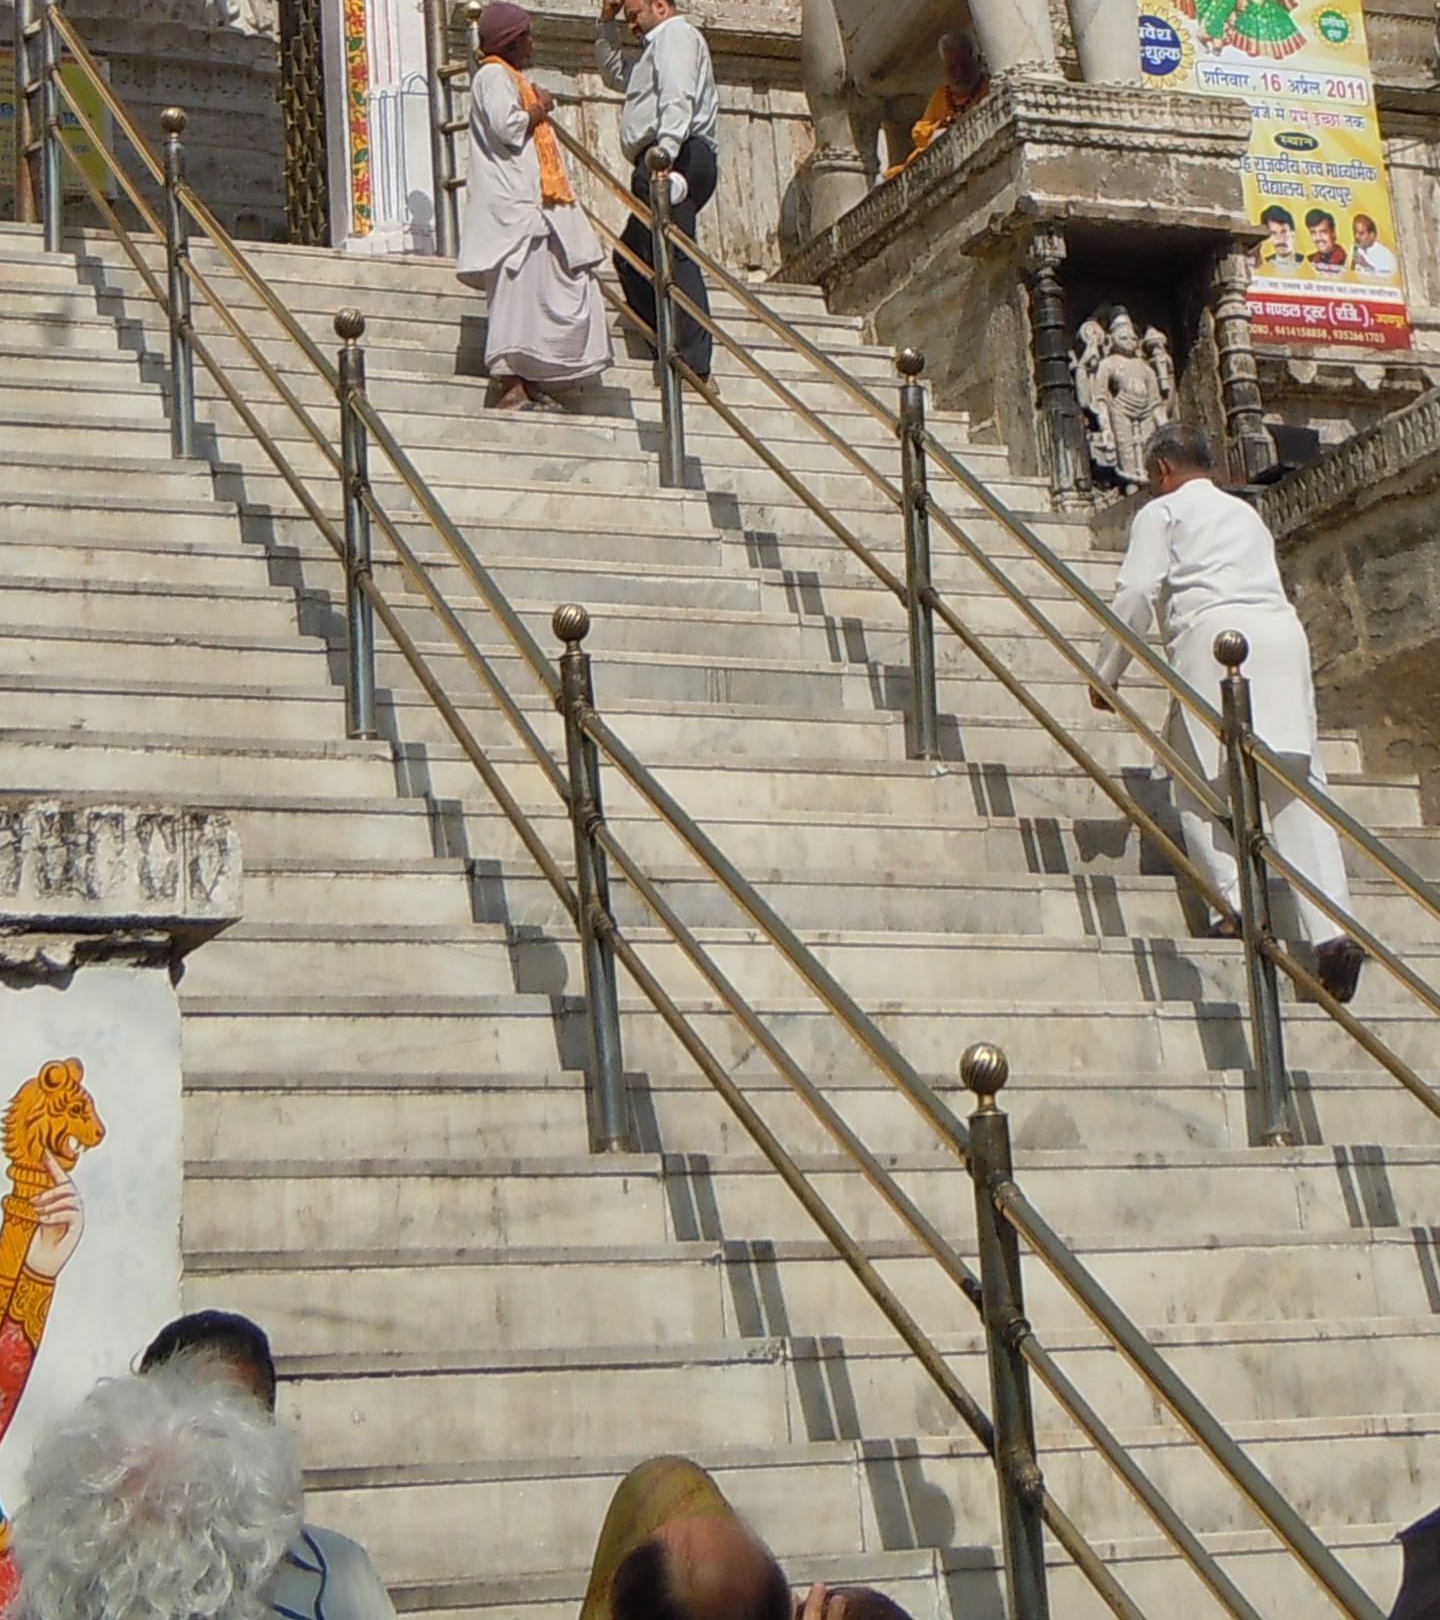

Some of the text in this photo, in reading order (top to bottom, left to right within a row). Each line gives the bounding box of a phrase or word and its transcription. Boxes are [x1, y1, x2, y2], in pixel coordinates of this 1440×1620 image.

[1261, 72, 1282, 93] 16
[1326, 79, 1366, 101] 2011
[1254, 152, 1299, 173] राजकीय
[1327, 158, 1377, 182] माध्यमिक
[1311, 184, 1352, 206] उदयपुर
